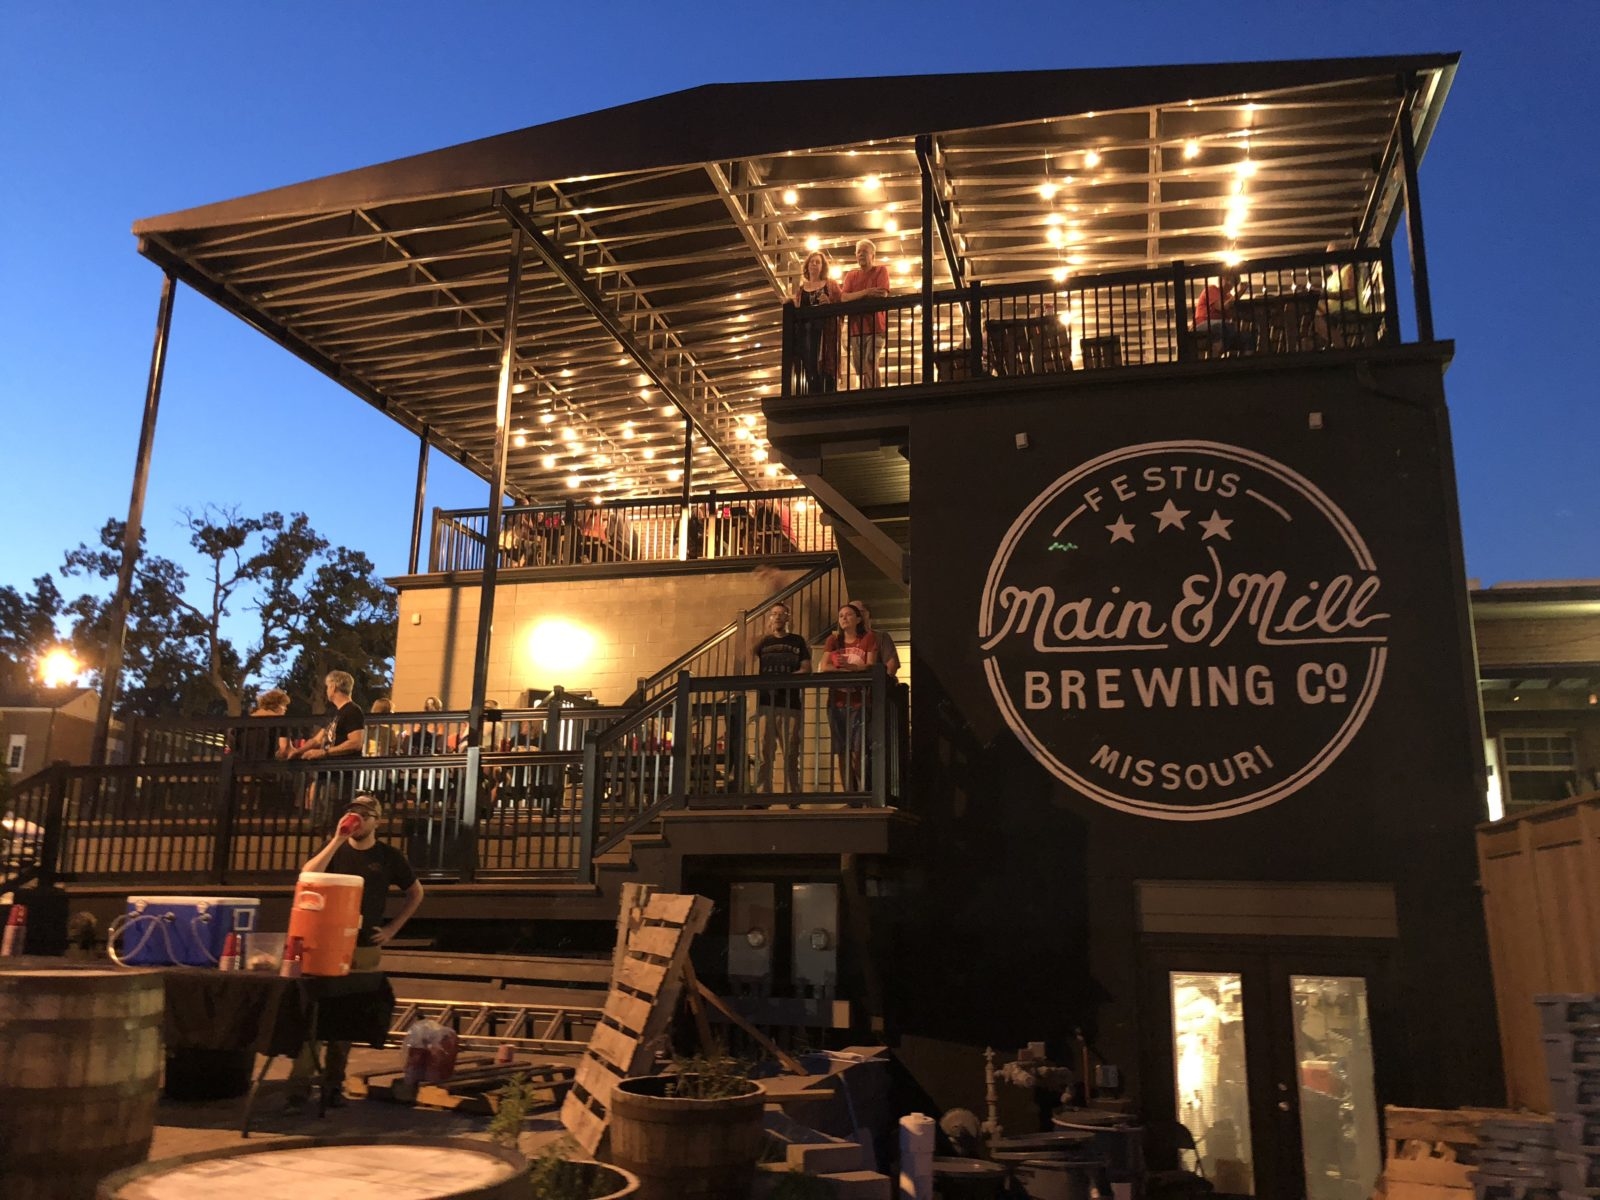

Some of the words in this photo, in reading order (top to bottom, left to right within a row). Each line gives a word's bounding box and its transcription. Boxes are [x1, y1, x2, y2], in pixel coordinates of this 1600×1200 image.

[1083, 465, 1241, 513] FESTUS
[980, 585, 1169, 653] Main
[1171, 546, 1223, 644] &
[1209, 571, 1392, 648] Mill
[1024, 665, 1275, 710] BREWING
[1089, 744, 1274, 791] MISSOURI
